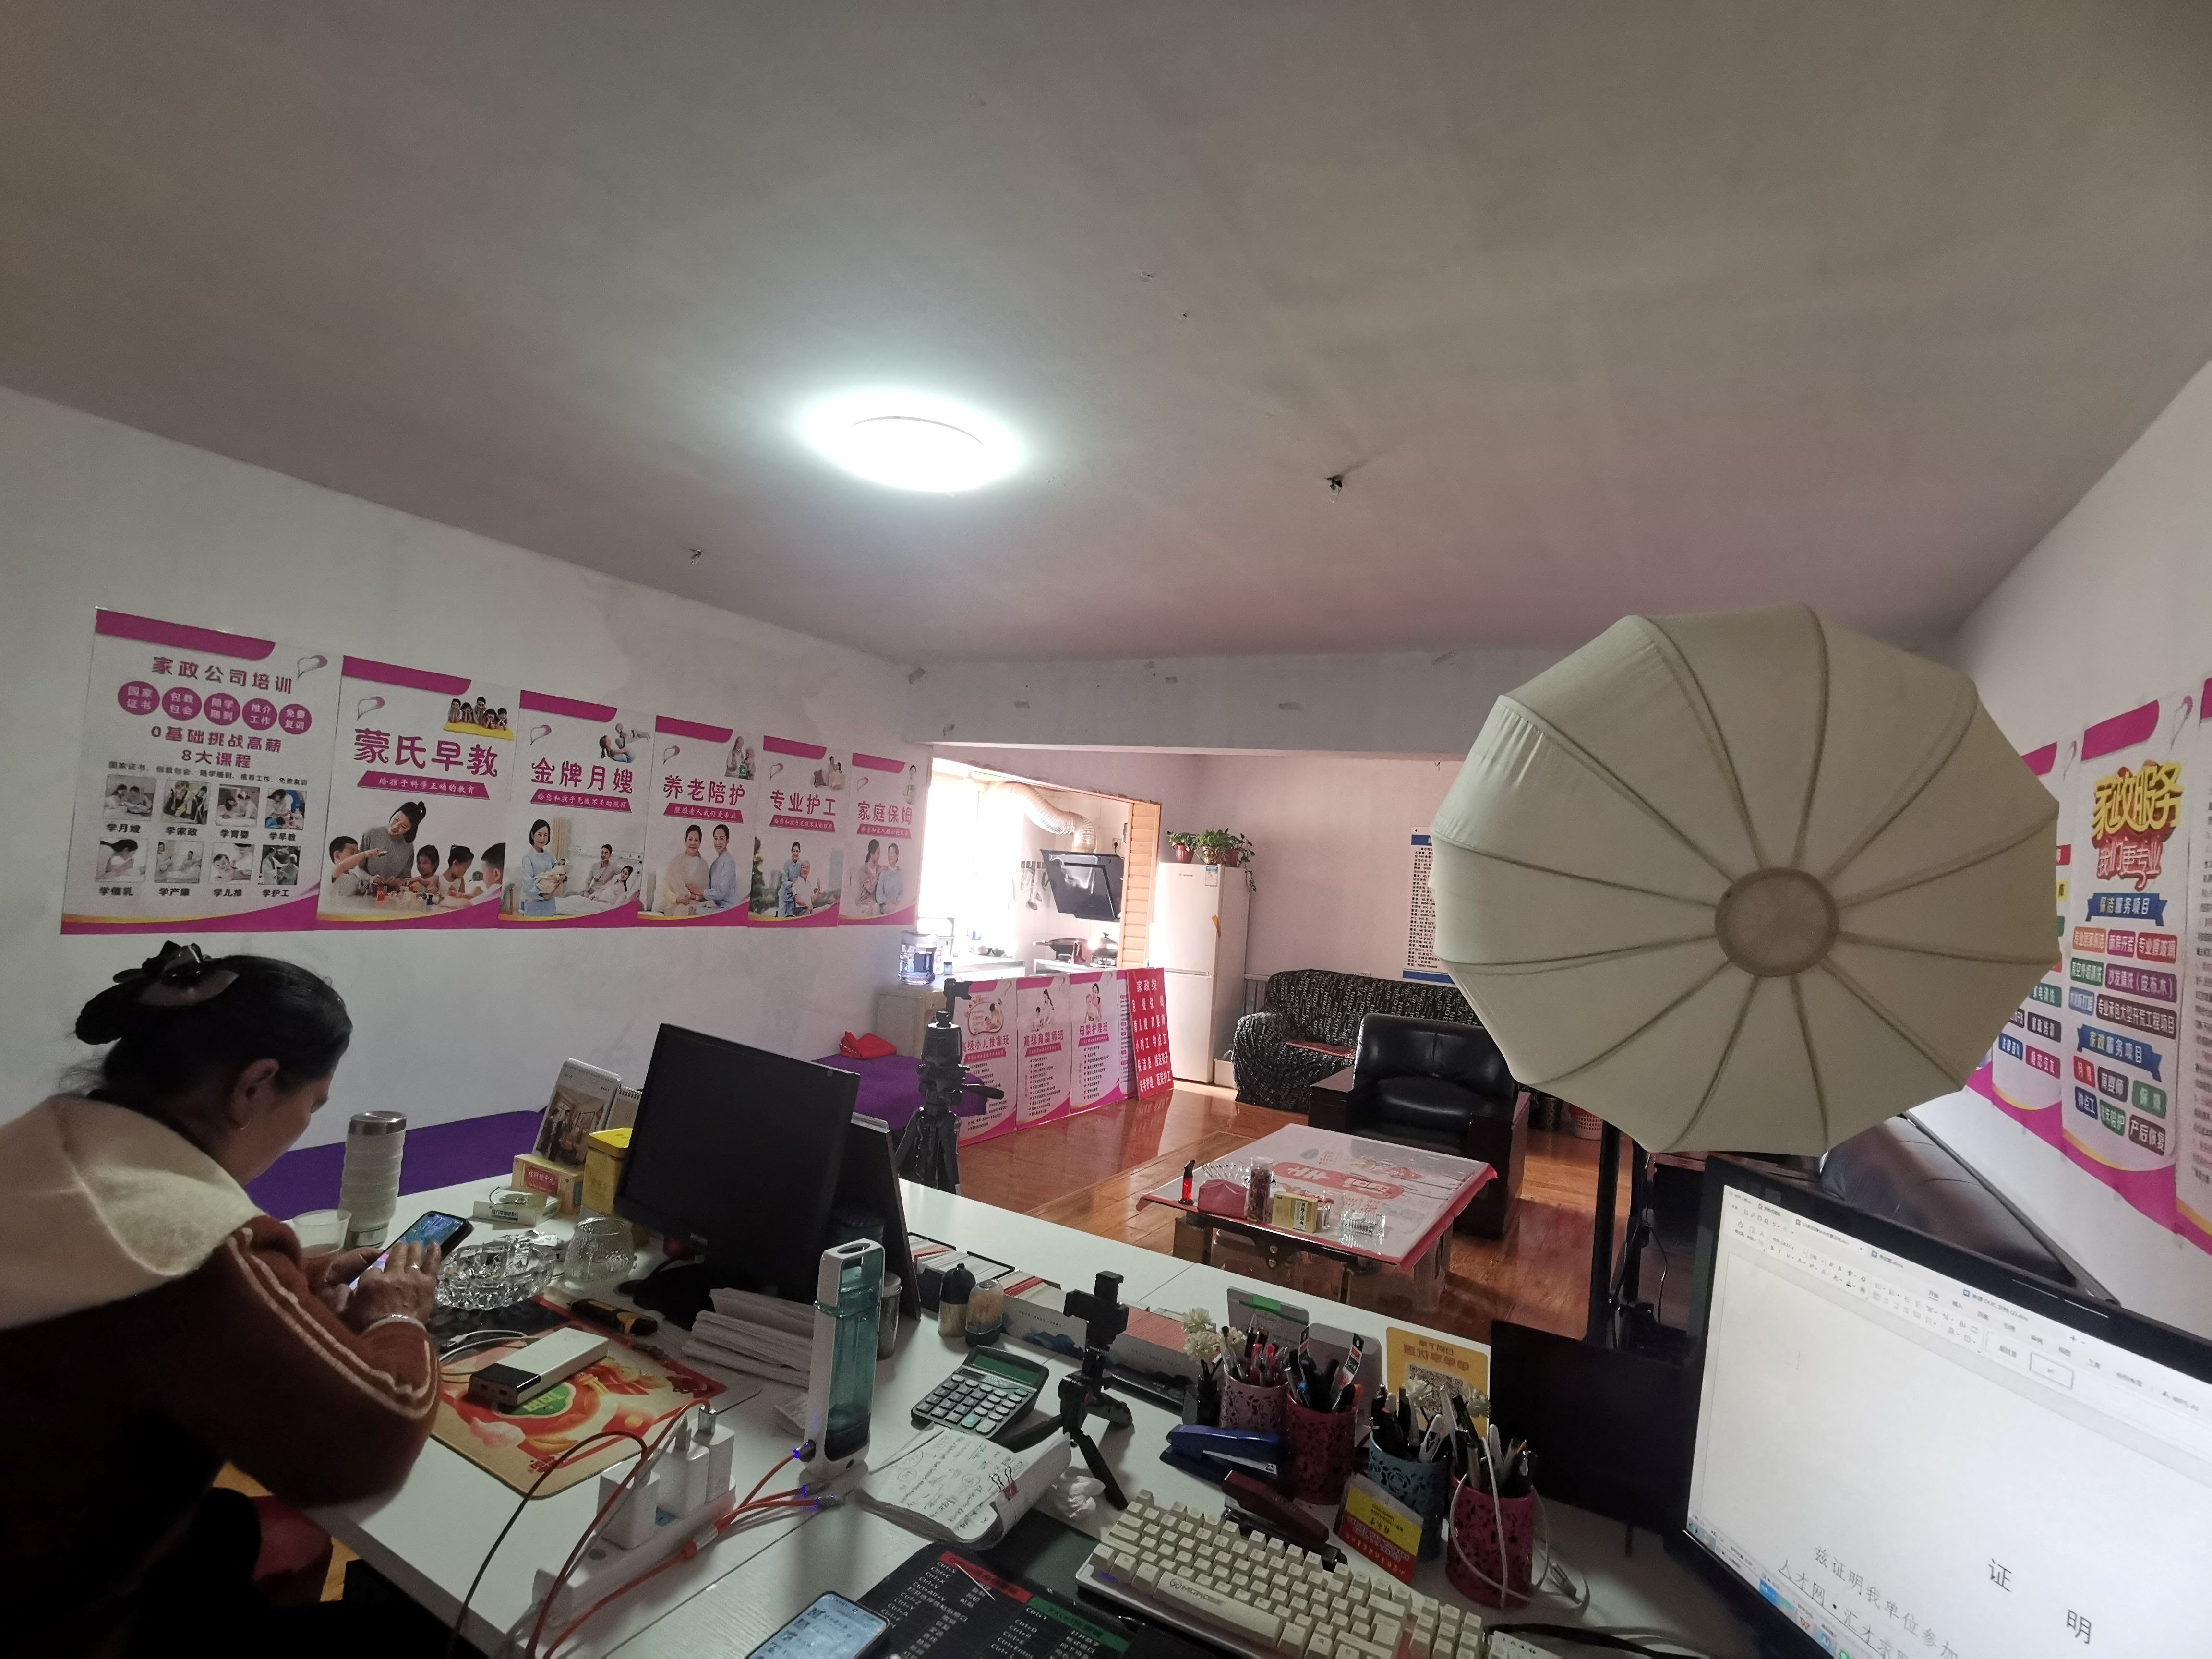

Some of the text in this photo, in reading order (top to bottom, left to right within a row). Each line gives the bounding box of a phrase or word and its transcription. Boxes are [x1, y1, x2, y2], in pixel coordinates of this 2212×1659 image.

[152, 657, 292, 694] 家政公司培训
[151, 726, 282, 753] 0基础挑战高薪
[354, 728, 498, 777] 蒙氏早教
[181, 749, 252, 768] 8大课程
[531, 757, 633, 794] 金牌月嫂
[663, 774, 745, 805] 养老陪护
[770, 789, 836, 816] 专业护工
[857, 800, 913, 825] 家庭保姆
[166, 826, 198, 837] 学家政
[262, 889, 289, 898] 学护工
[1987, 1558, 2092, 1645] 证 明
